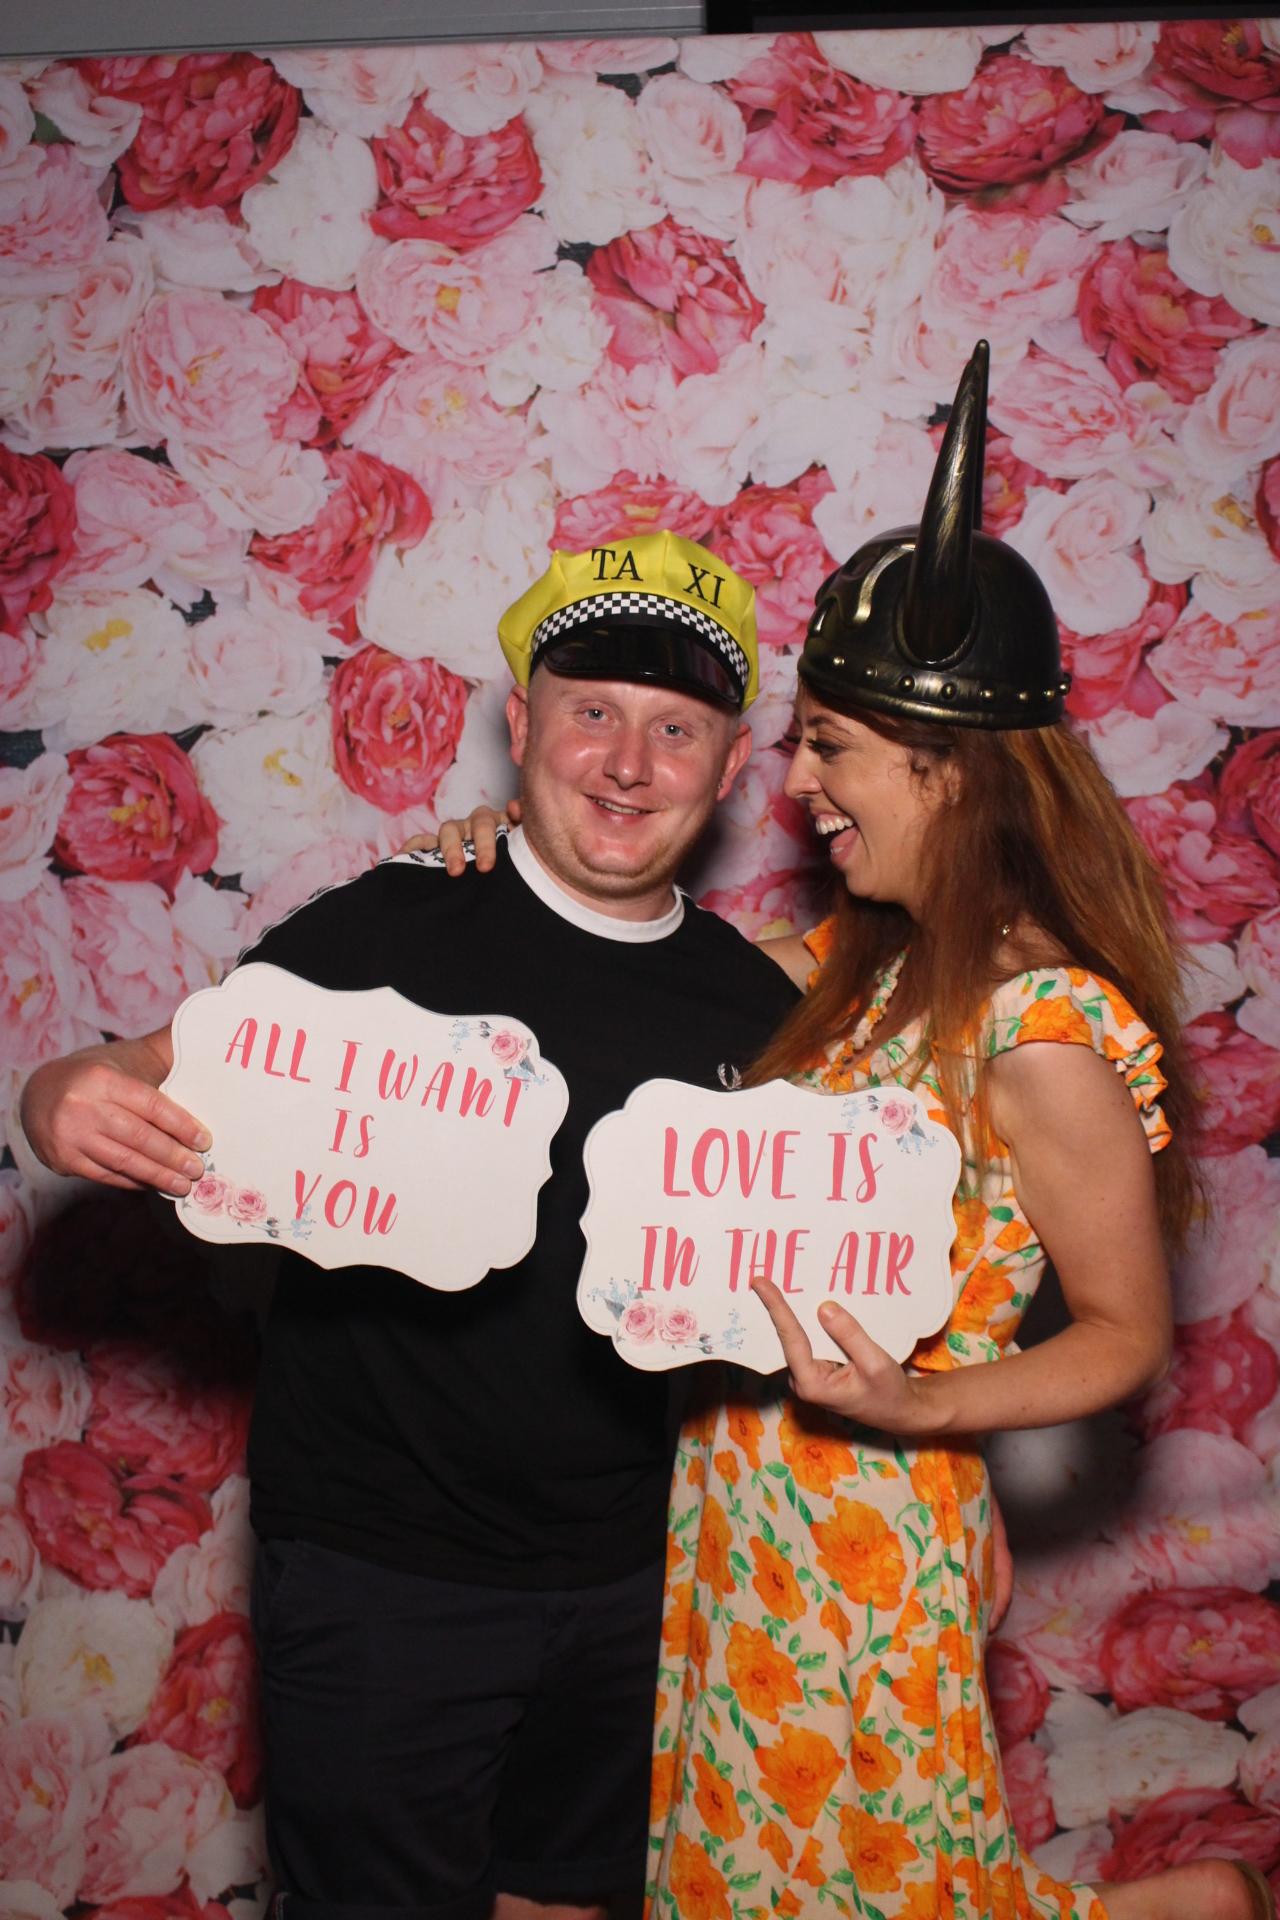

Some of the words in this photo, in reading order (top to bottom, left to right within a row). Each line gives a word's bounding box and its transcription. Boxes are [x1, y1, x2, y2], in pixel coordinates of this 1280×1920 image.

[224, 1017, 311, 1083] ALL
[334, 1040, 363, 1094] I
[378, 1048, 530, 1128] WANT
[328, 1108, 376, 1158] IS
[662, 1126, 801, 1199] LOVE
[826, 1132, 884, 1203] IS
[294, 1169, 399, 1236] YOU
[637, 1225, 700, 1292] IN
[725, 1228, 811, 1294] THE
[828, 1230, 915, 1296] AIR
